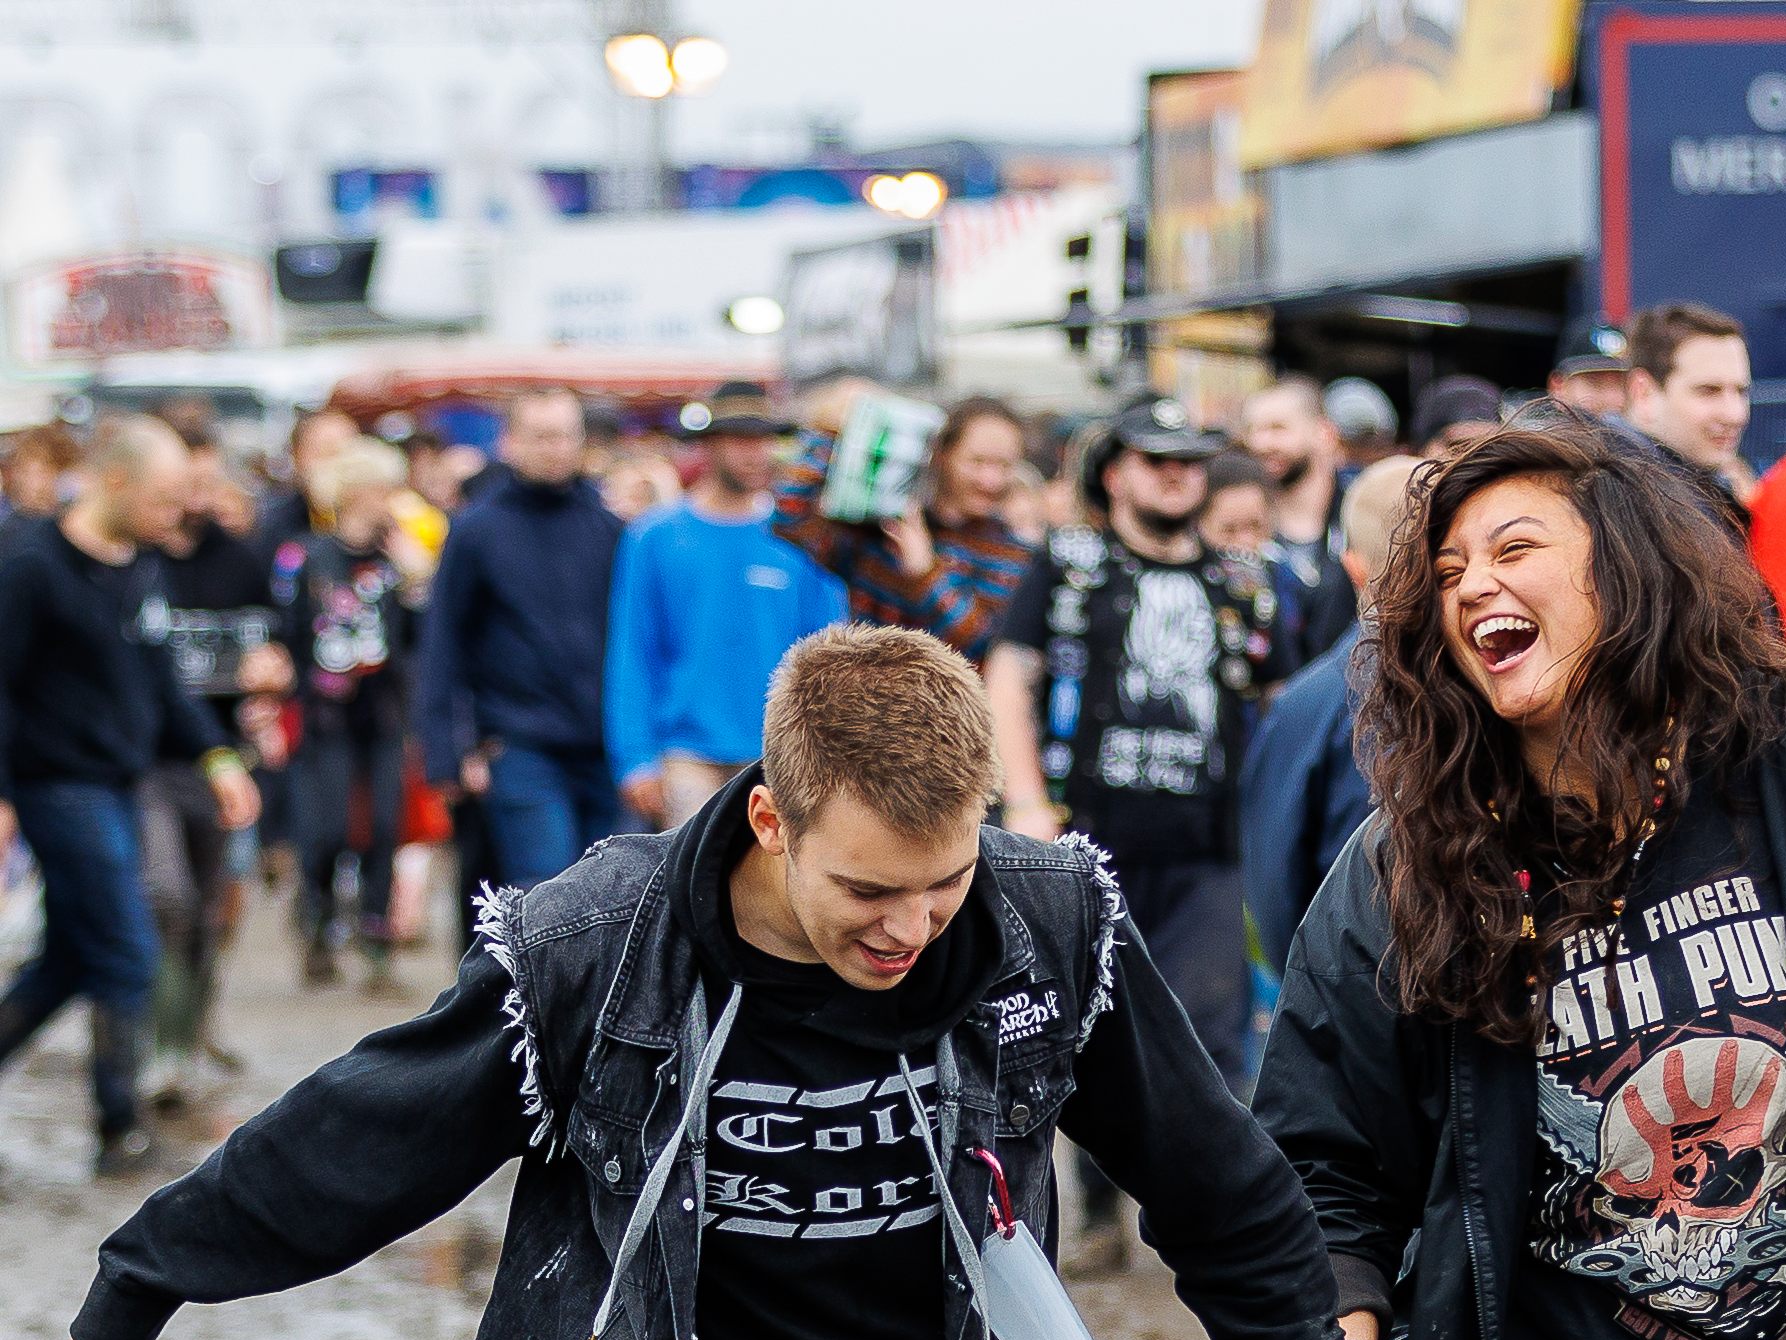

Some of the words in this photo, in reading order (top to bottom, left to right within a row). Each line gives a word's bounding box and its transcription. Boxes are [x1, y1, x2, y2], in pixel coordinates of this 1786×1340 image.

[1562, 924, 1630, 971] FIVE
[1643, 876, 1760, 941] FINGER
[1536, 954, 1663, 1057] ATH
